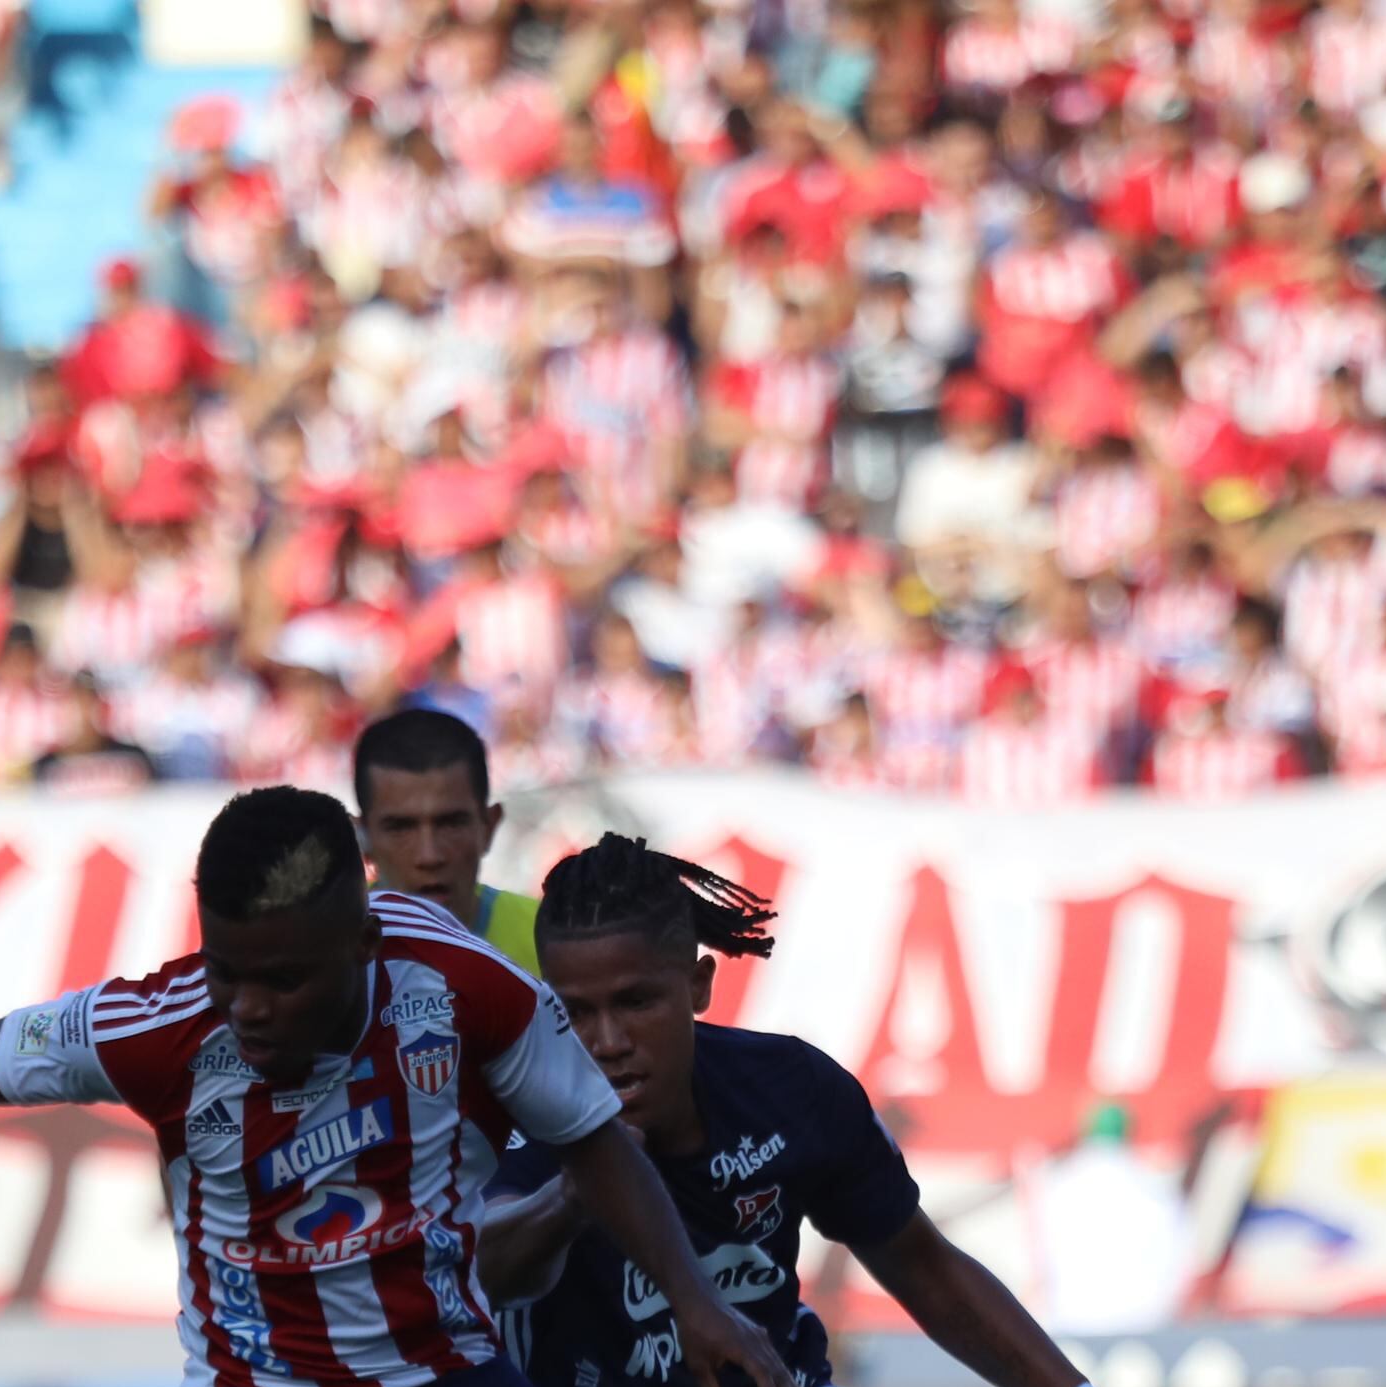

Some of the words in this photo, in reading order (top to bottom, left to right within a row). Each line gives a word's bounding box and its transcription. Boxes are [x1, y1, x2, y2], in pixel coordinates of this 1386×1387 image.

[411, 1050, 451, 1067] JUNIOR
[188, 1119, 242, 1137] adidas
[271, 1104, 385, 1189] AGUILA
[710, 1133, 787, 1191] Pilsen
[226, 1207, 433, 1265] OLIMPICA
